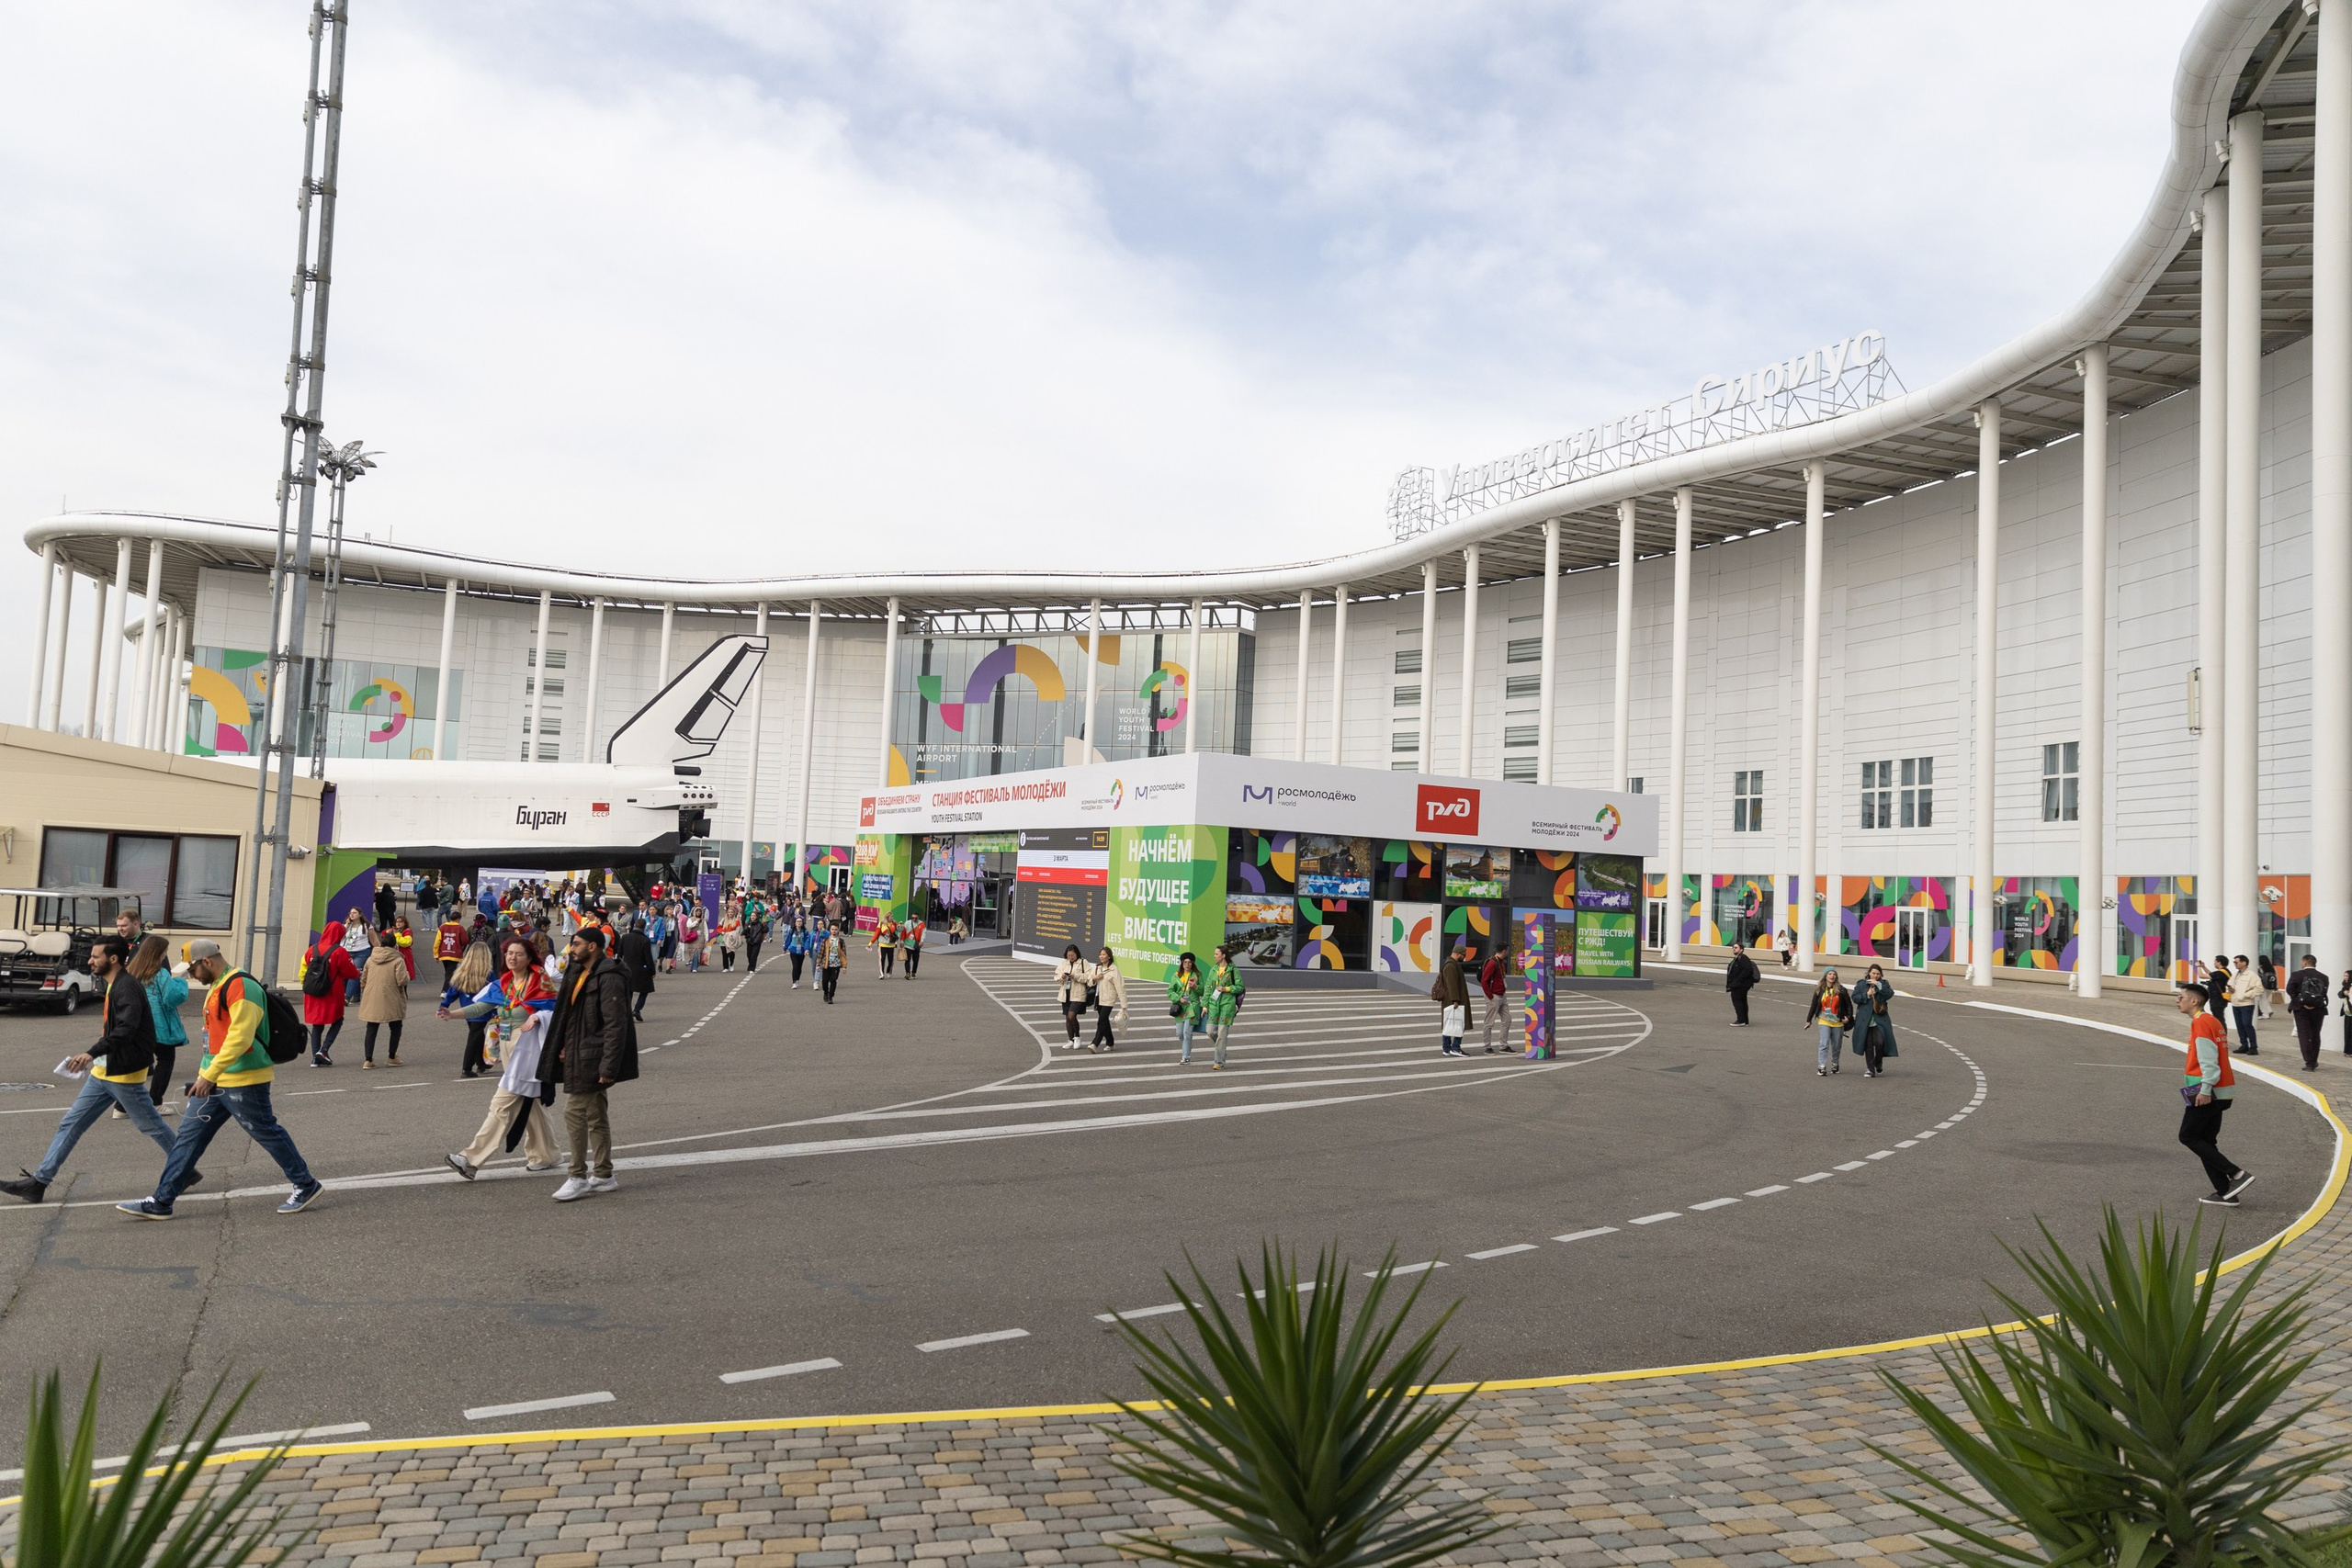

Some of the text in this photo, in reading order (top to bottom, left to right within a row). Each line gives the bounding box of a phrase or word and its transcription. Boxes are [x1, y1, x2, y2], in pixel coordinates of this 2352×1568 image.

[1440, 329, 1883, 502] Университет Сириус
[917, 744, 1017, 753] WYF INTERNATIONAL
[916, 754, 957, 762] AIRPORT
[932, 779, 1067, 808] СТАНЦИЯ ФЕСТИВАЛЬ МОЛОДЁЖИ
[1277, 787, 1357, 802] росмолодёжь
[515, 805, 567, 830] Буран
[931, 812, 983, 823] YOUTH FESTIVAL STATION
[1128, 834, 1192, 863] НАЧНЁМ
[1118, 877, 1190, 908] БУДУЩЕЕ
[1107, 932, 1122, 943] LET'S
[1125, 916, 1188, 945] ВМЕСТЕ!
[1578, 928, 1634, 938] ПУТЕШЕСТВУЙ
[1577, 937, 1606, 947] С РЖД!
[1112, 946, 1182, 965] START FUTURE TOGETHE
